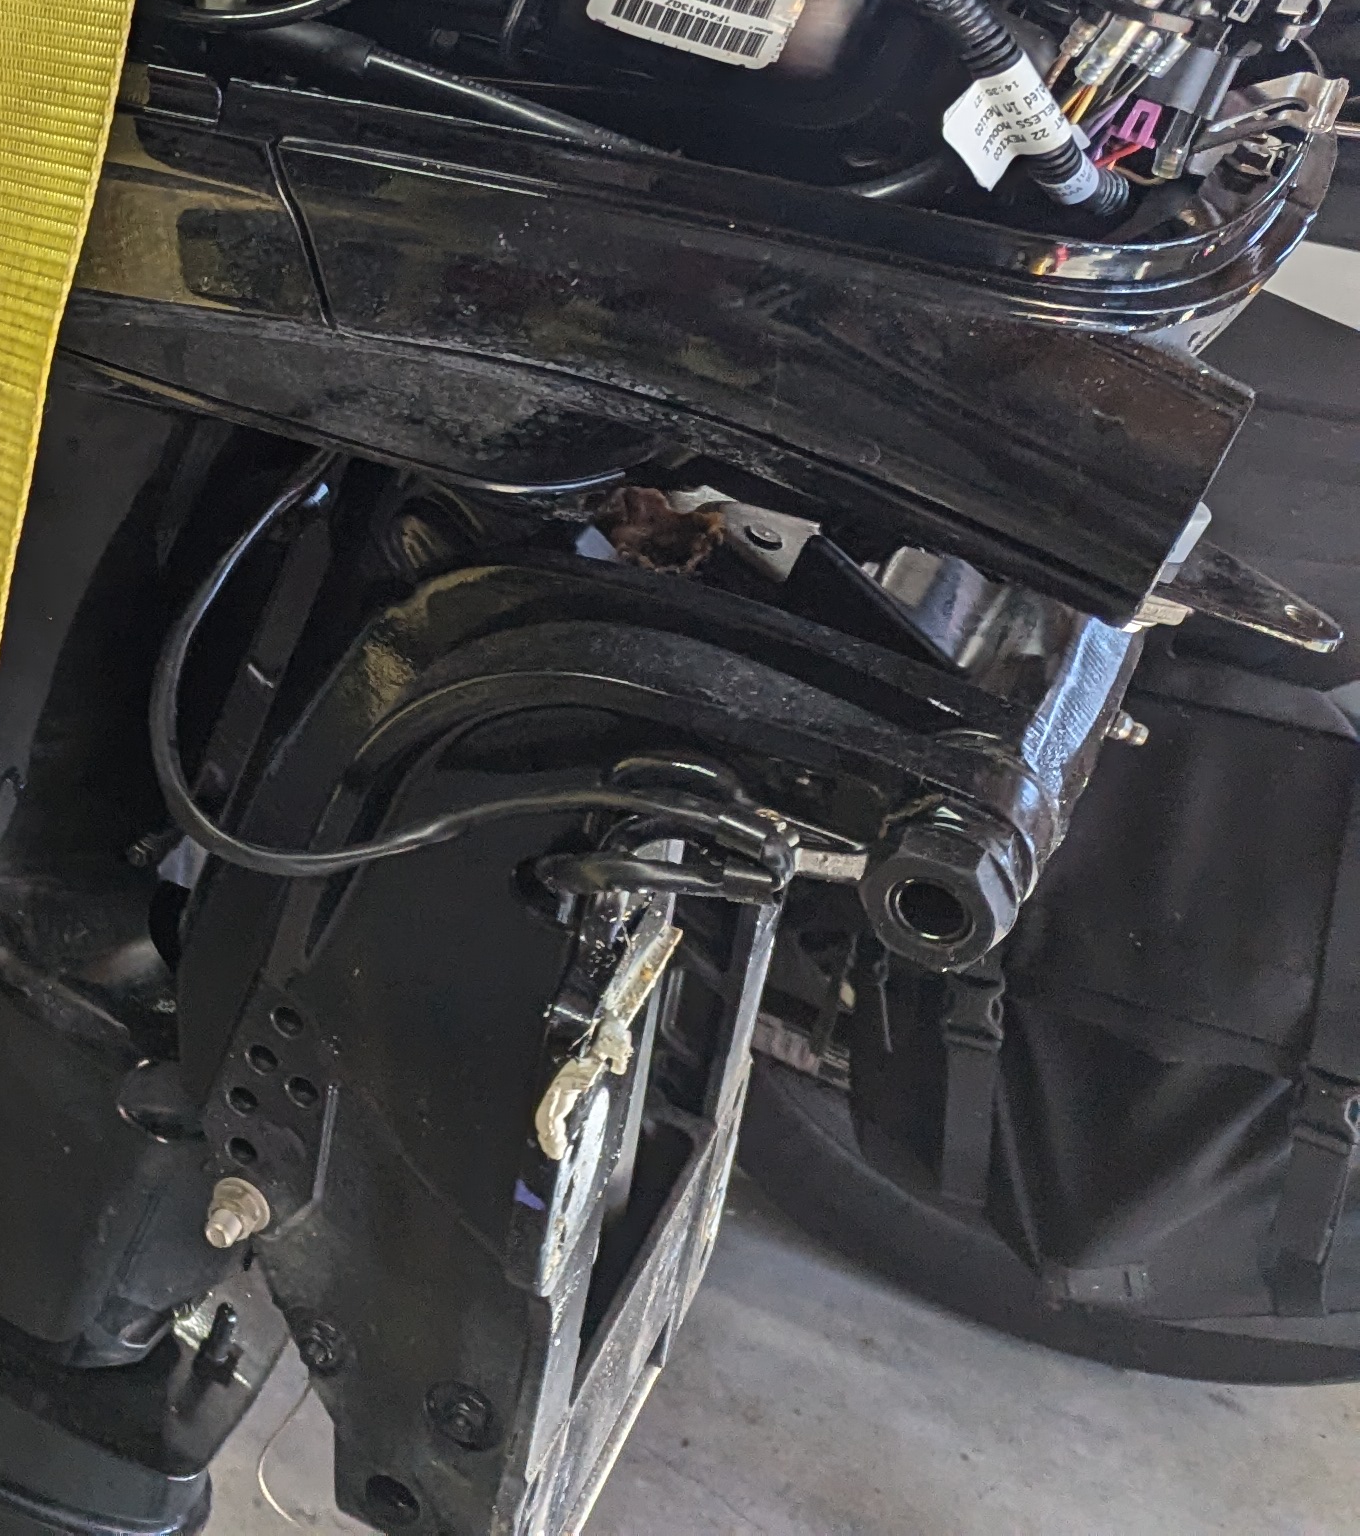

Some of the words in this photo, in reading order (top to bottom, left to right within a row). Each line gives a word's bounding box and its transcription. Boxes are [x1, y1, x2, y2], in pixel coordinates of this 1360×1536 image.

[974, 105, 1005, 137] Mexico
[1030, 127, 1050, 142] 22
[982, 121, 1012, 155] MODULE
[993, 133, 1028, 162] MEXICO
